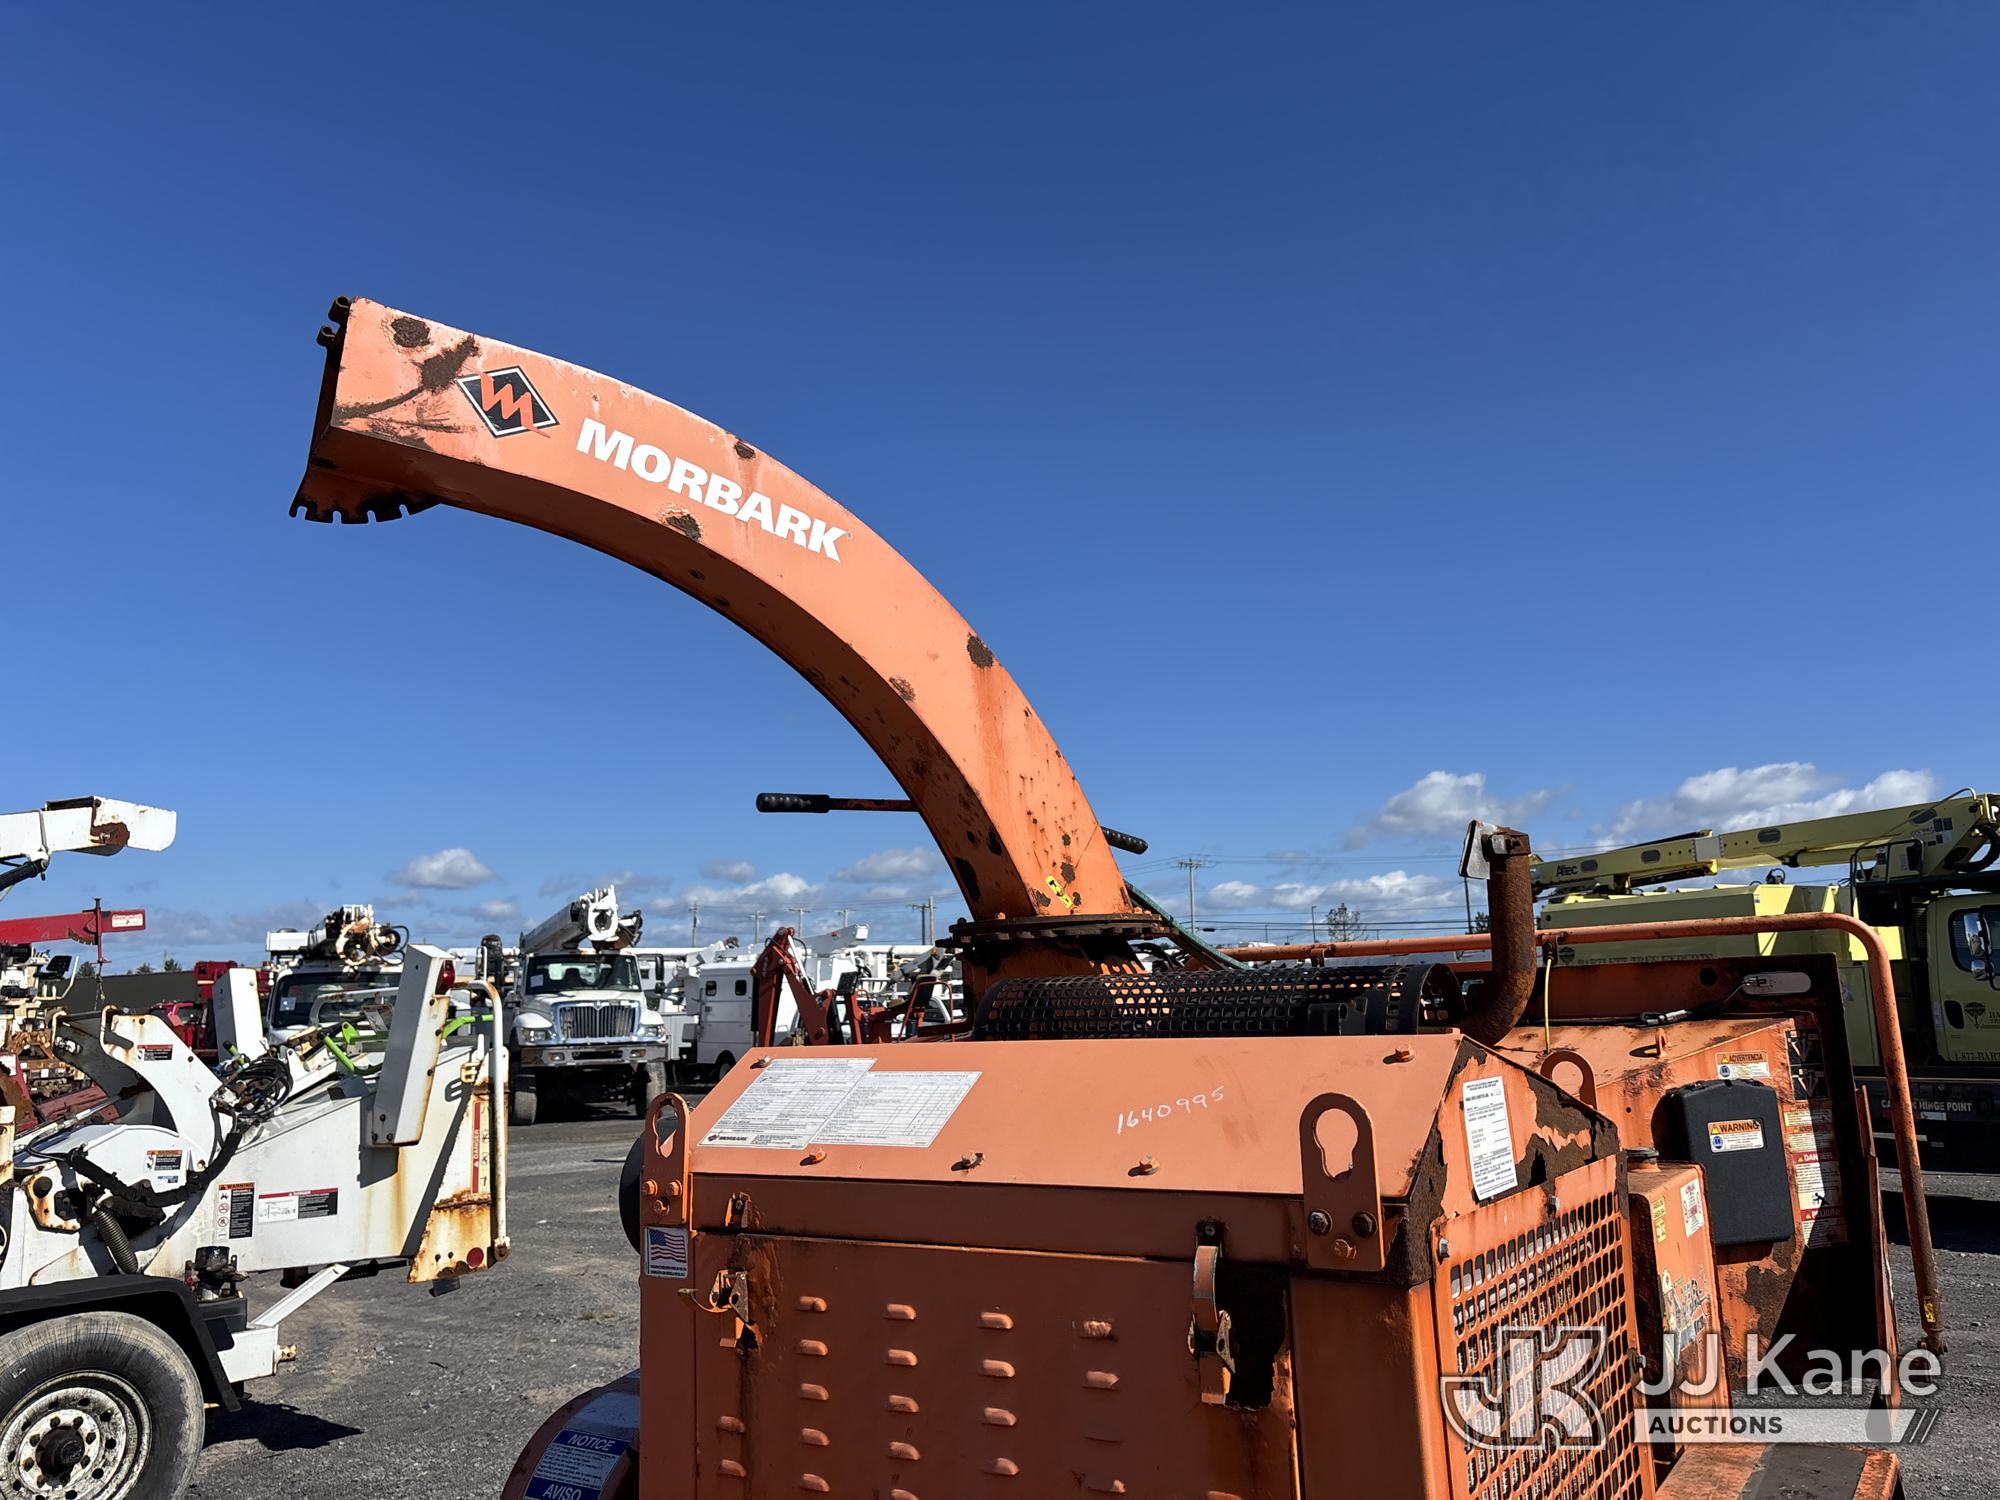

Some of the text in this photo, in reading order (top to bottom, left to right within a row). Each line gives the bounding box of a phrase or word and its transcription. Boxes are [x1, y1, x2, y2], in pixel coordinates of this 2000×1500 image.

[576, 417, 847, 562] MORBARK
[1117, 1085, 1224, 1134] 1640995
[1919, 1101, 1945, 1111] HINGE
[1946, 1101, 1972, 1112] POINT
[1720, 1120, 1759, 1132] WARNING
[567, 1433, 616, 1451] NOTICE
[543, 1483, 582, 1500] AVISO
